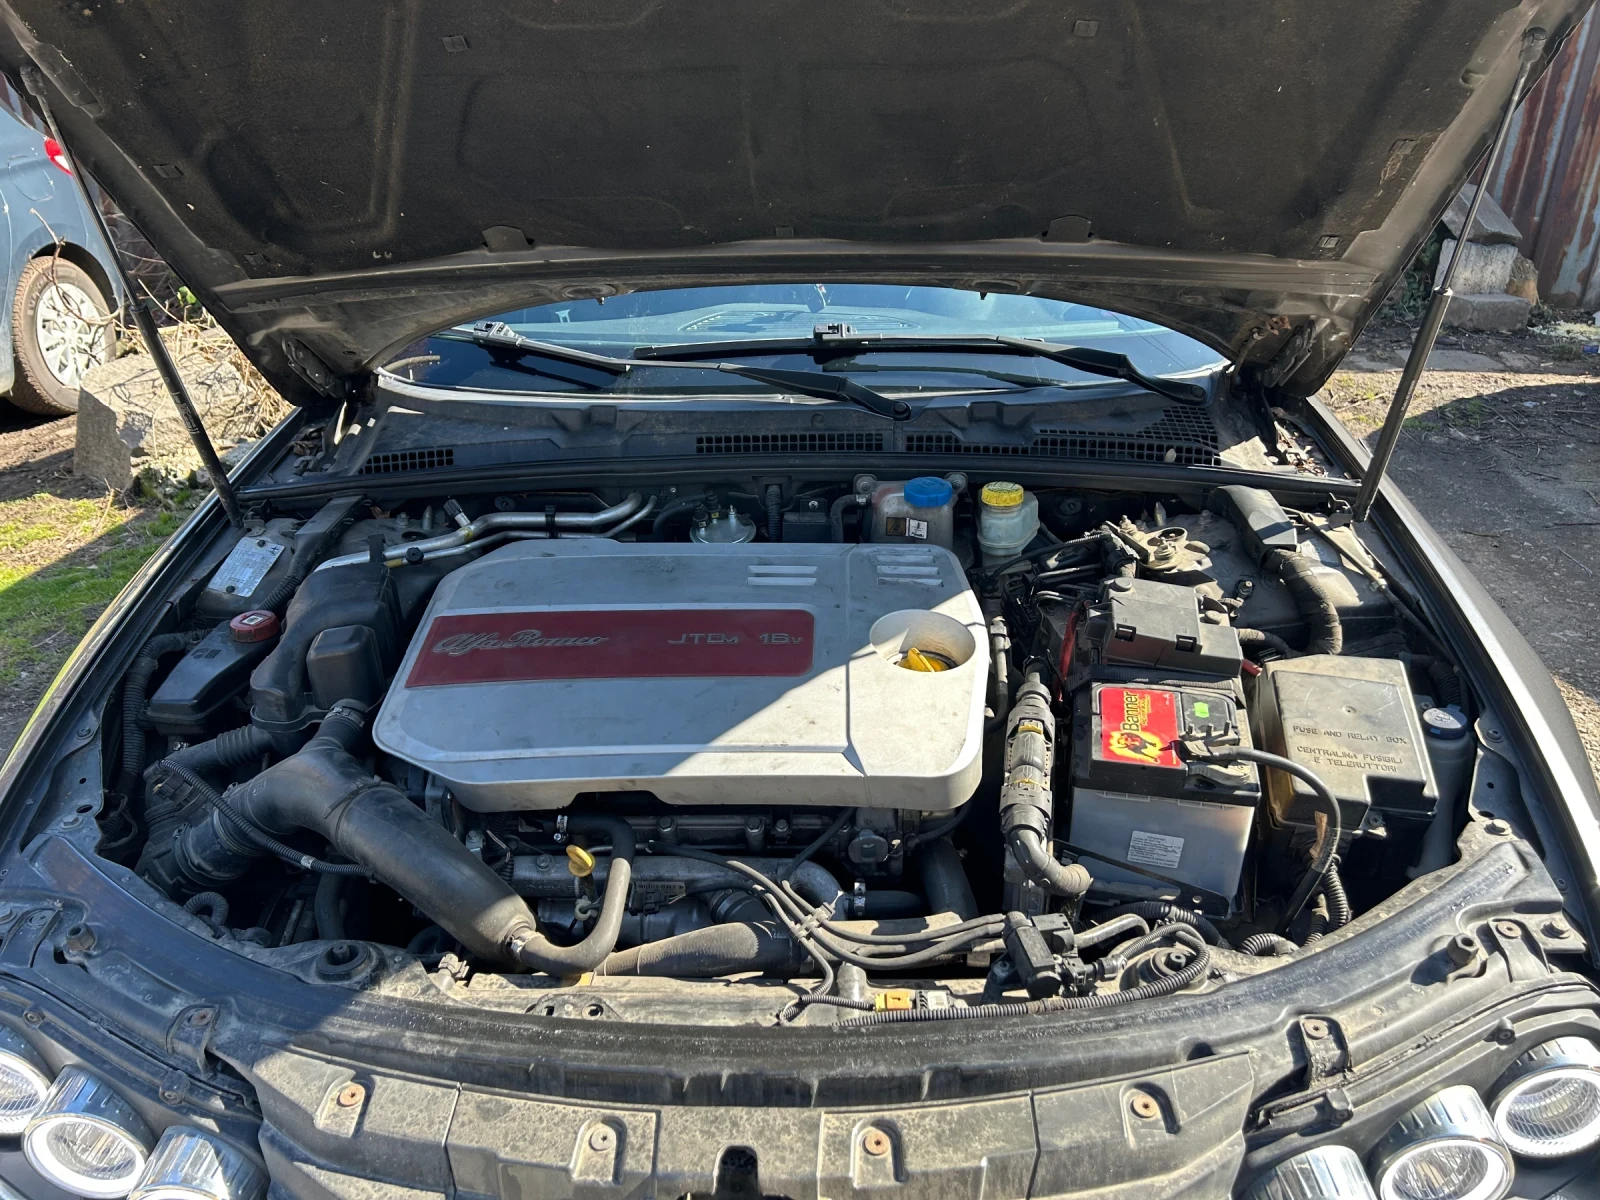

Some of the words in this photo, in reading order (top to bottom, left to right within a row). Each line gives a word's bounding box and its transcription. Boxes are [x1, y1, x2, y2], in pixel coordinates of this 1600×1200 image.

[433, 632, 507, 656] Alfa
[508, 629, 609, 648] Romeo
[1122, 691, 1140, 732] Banner
[1292, 725, 1318, 735] FUSE
[1323, 730, 1342, 738] AND
[1347, 733, 1380, 742] RELAY
[1386, 736, 1407, 744] BOX
[1296, 746, 1358, 760] CENTRALINA
[1363, 754, 1403, 764] FUSIBILI
[1327, 758, 1397, 772] TELERUTTORI
